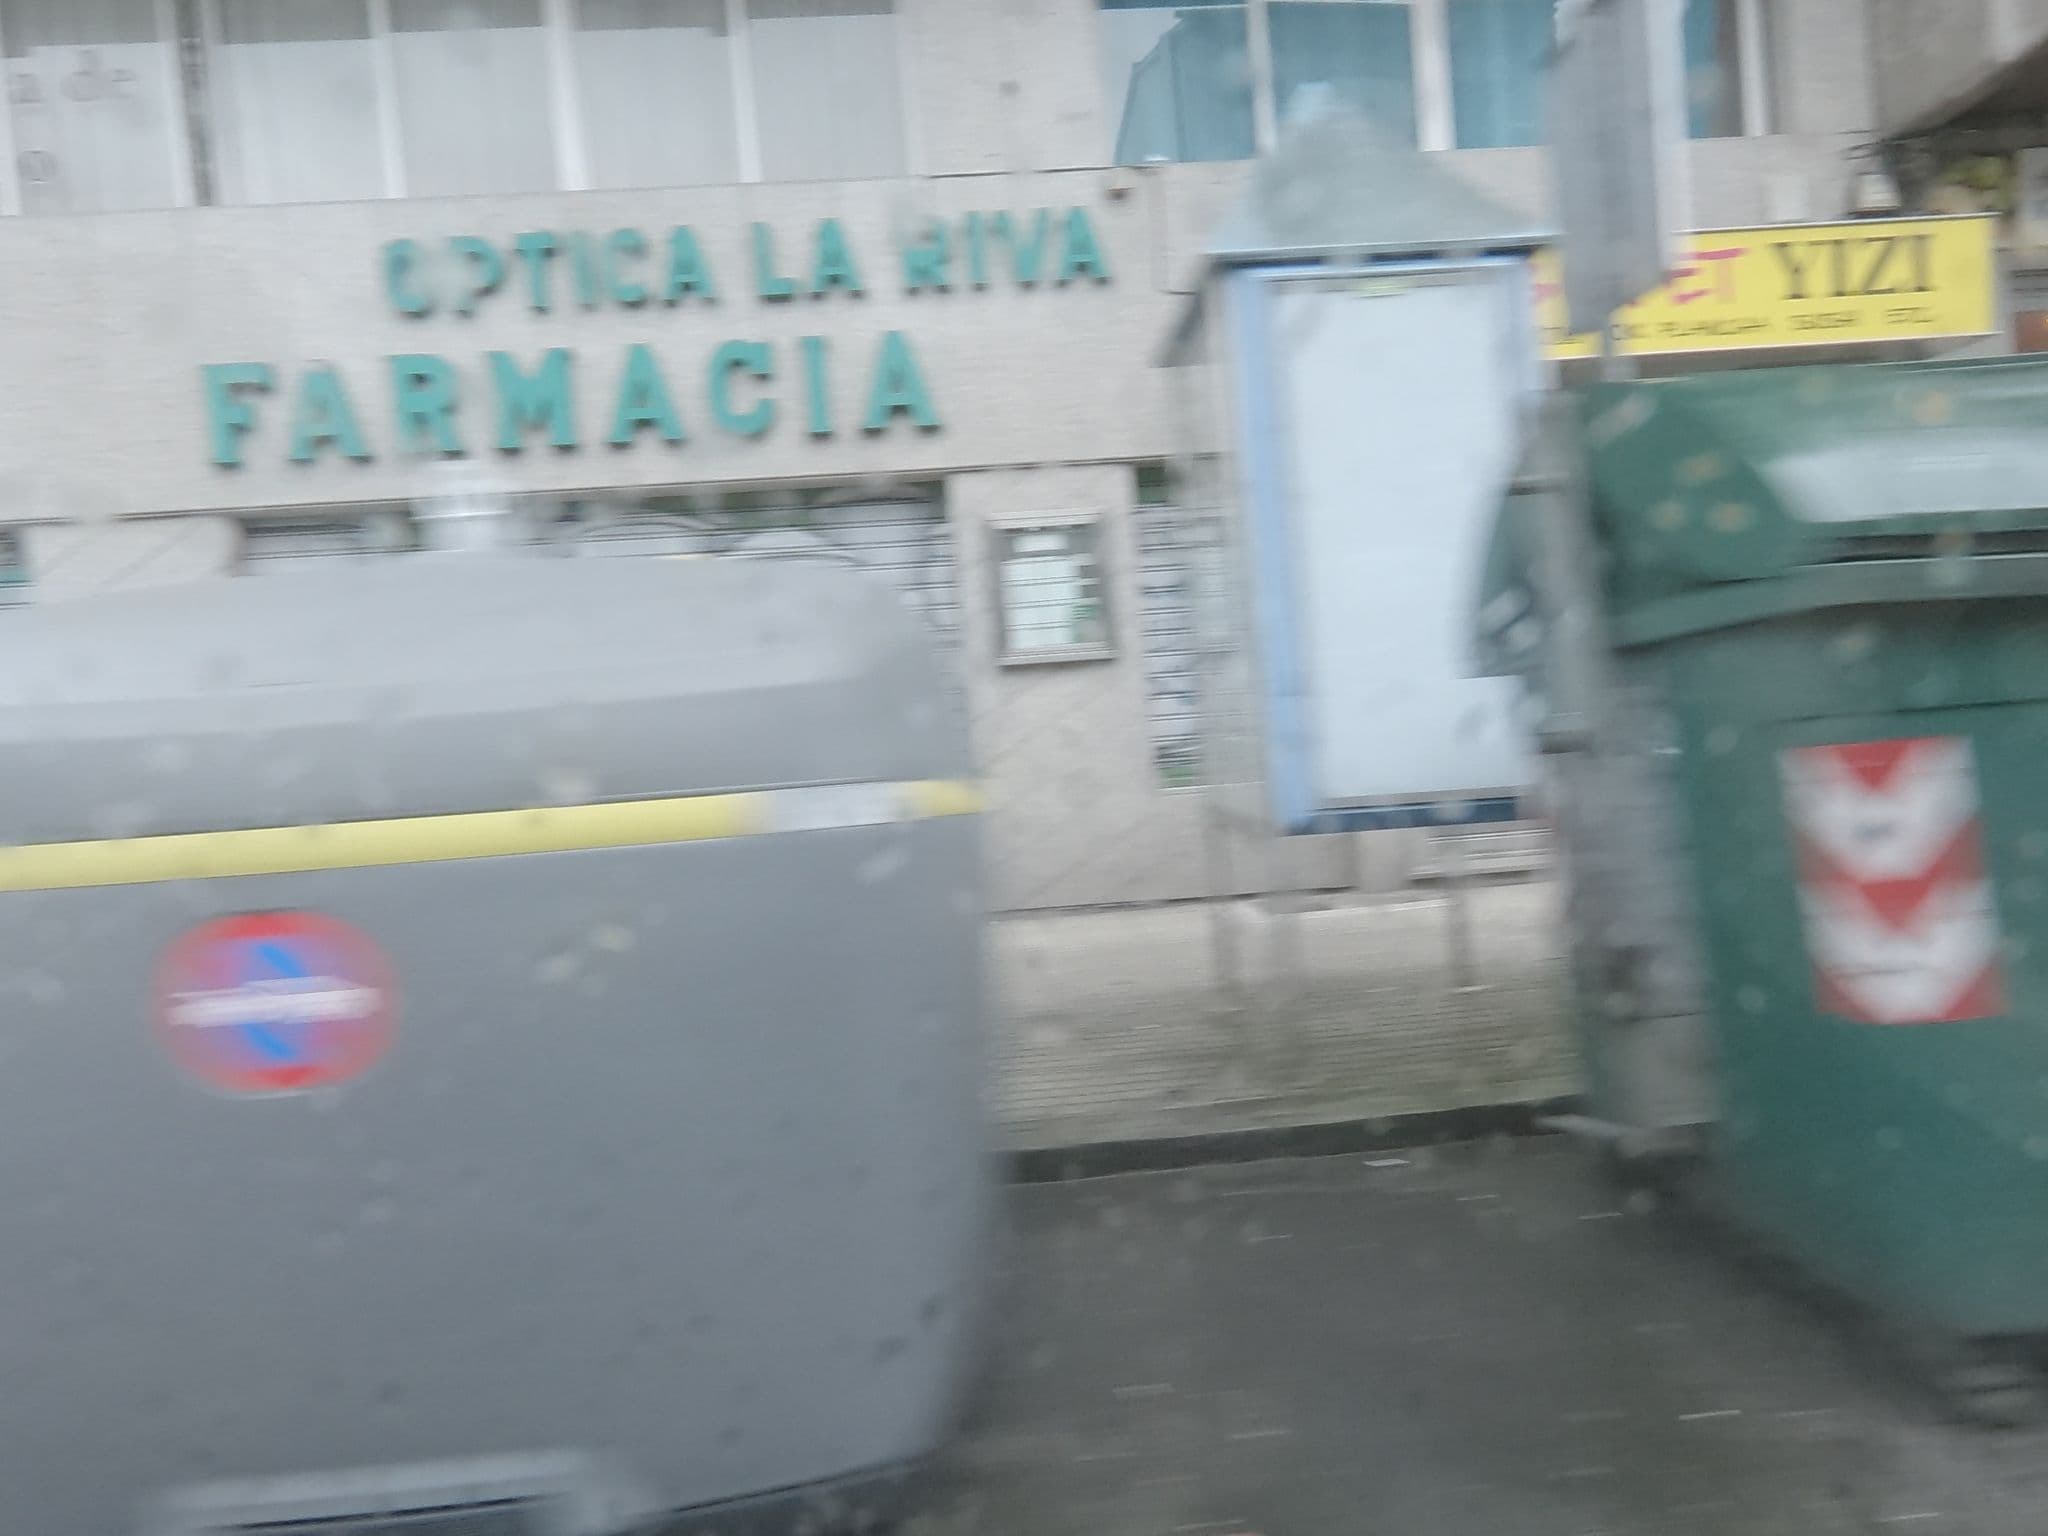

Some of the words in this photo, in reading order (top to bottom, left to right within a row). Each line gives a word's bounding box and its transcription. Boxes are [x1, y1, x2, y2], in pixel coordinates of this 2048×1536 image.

[752, 217, 864, 302] LA
[900, 205, 1112, 296] RIVA
[1768, 234, 1940, 300] YIZI
[201, 329, 944, 468] FARMACIA
